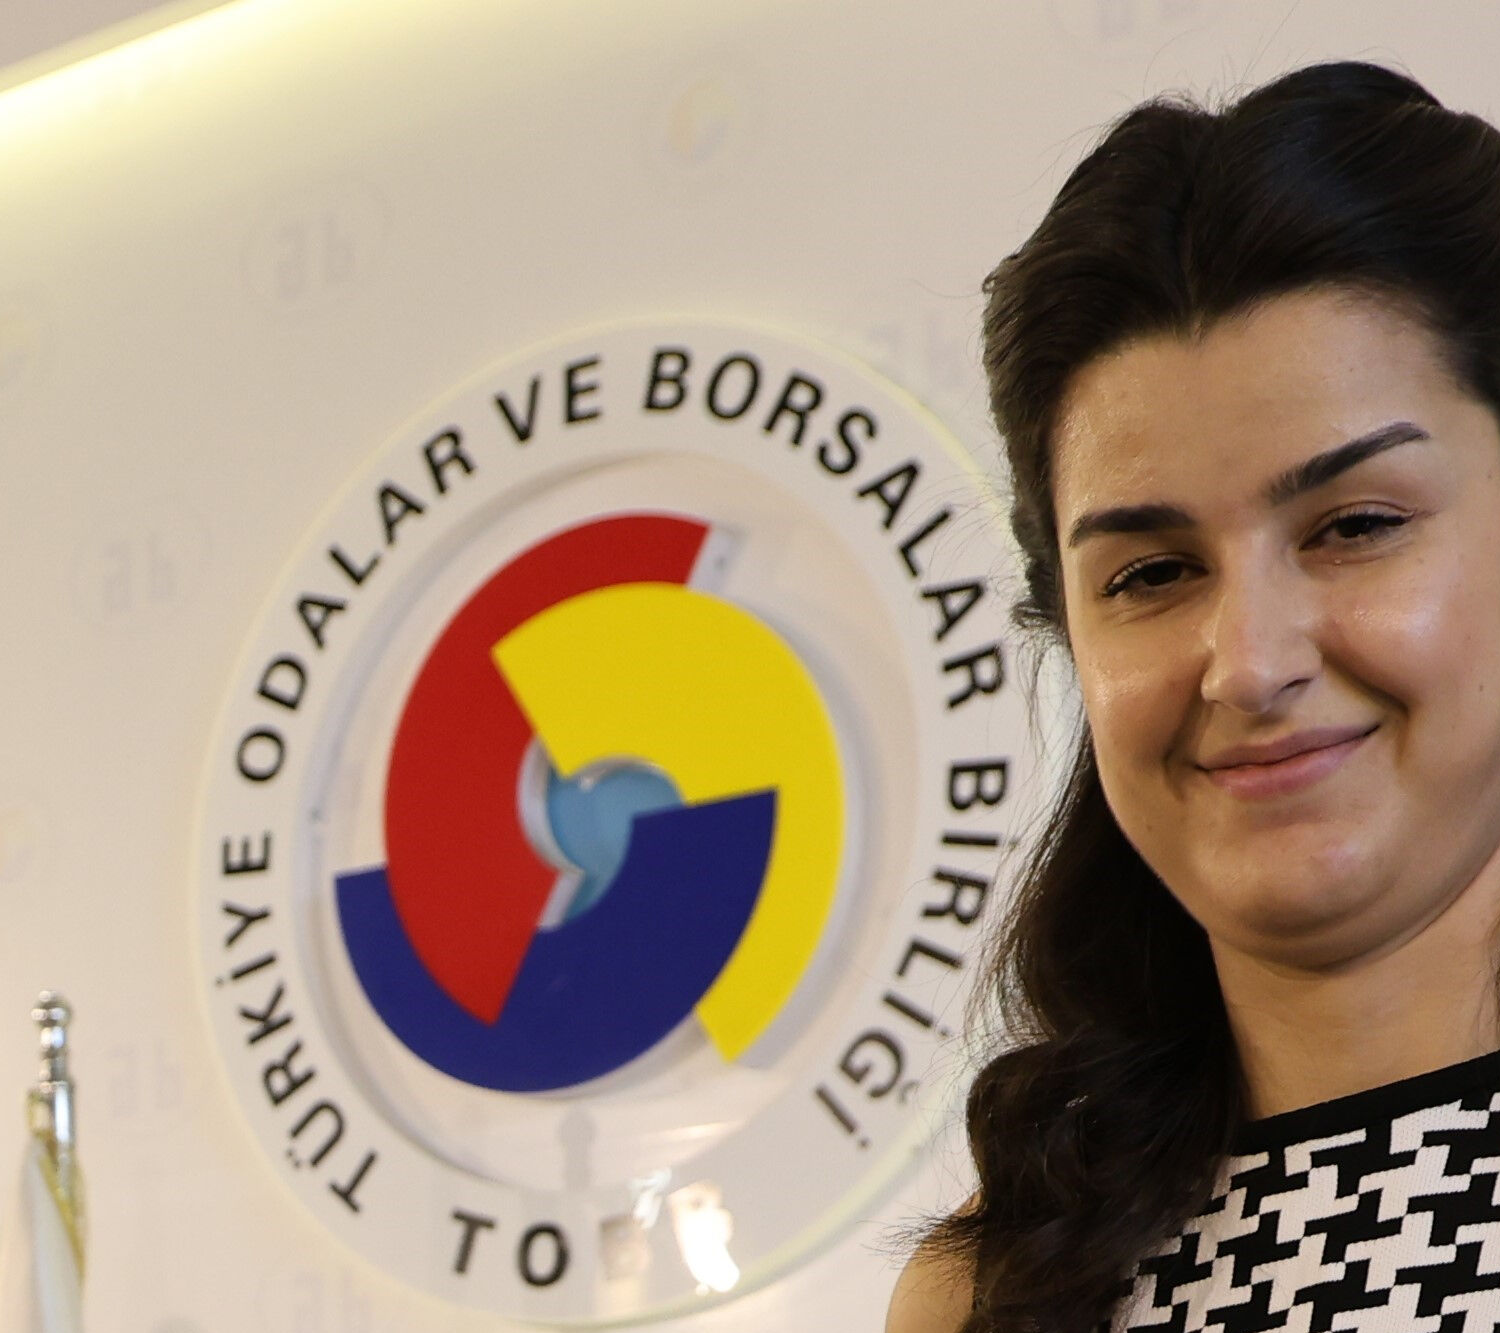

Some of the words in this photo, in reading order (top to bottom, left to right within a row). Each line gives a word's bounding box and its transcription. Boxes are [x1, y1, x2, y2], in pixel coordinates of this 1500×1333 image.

[495, 355, 604, 445] VE
[643, 347, 1007, 709] BORSALAR
[236, 428, 476, 784] ODALAR
[216, 832, 380, 1213] TÜRKİYE
